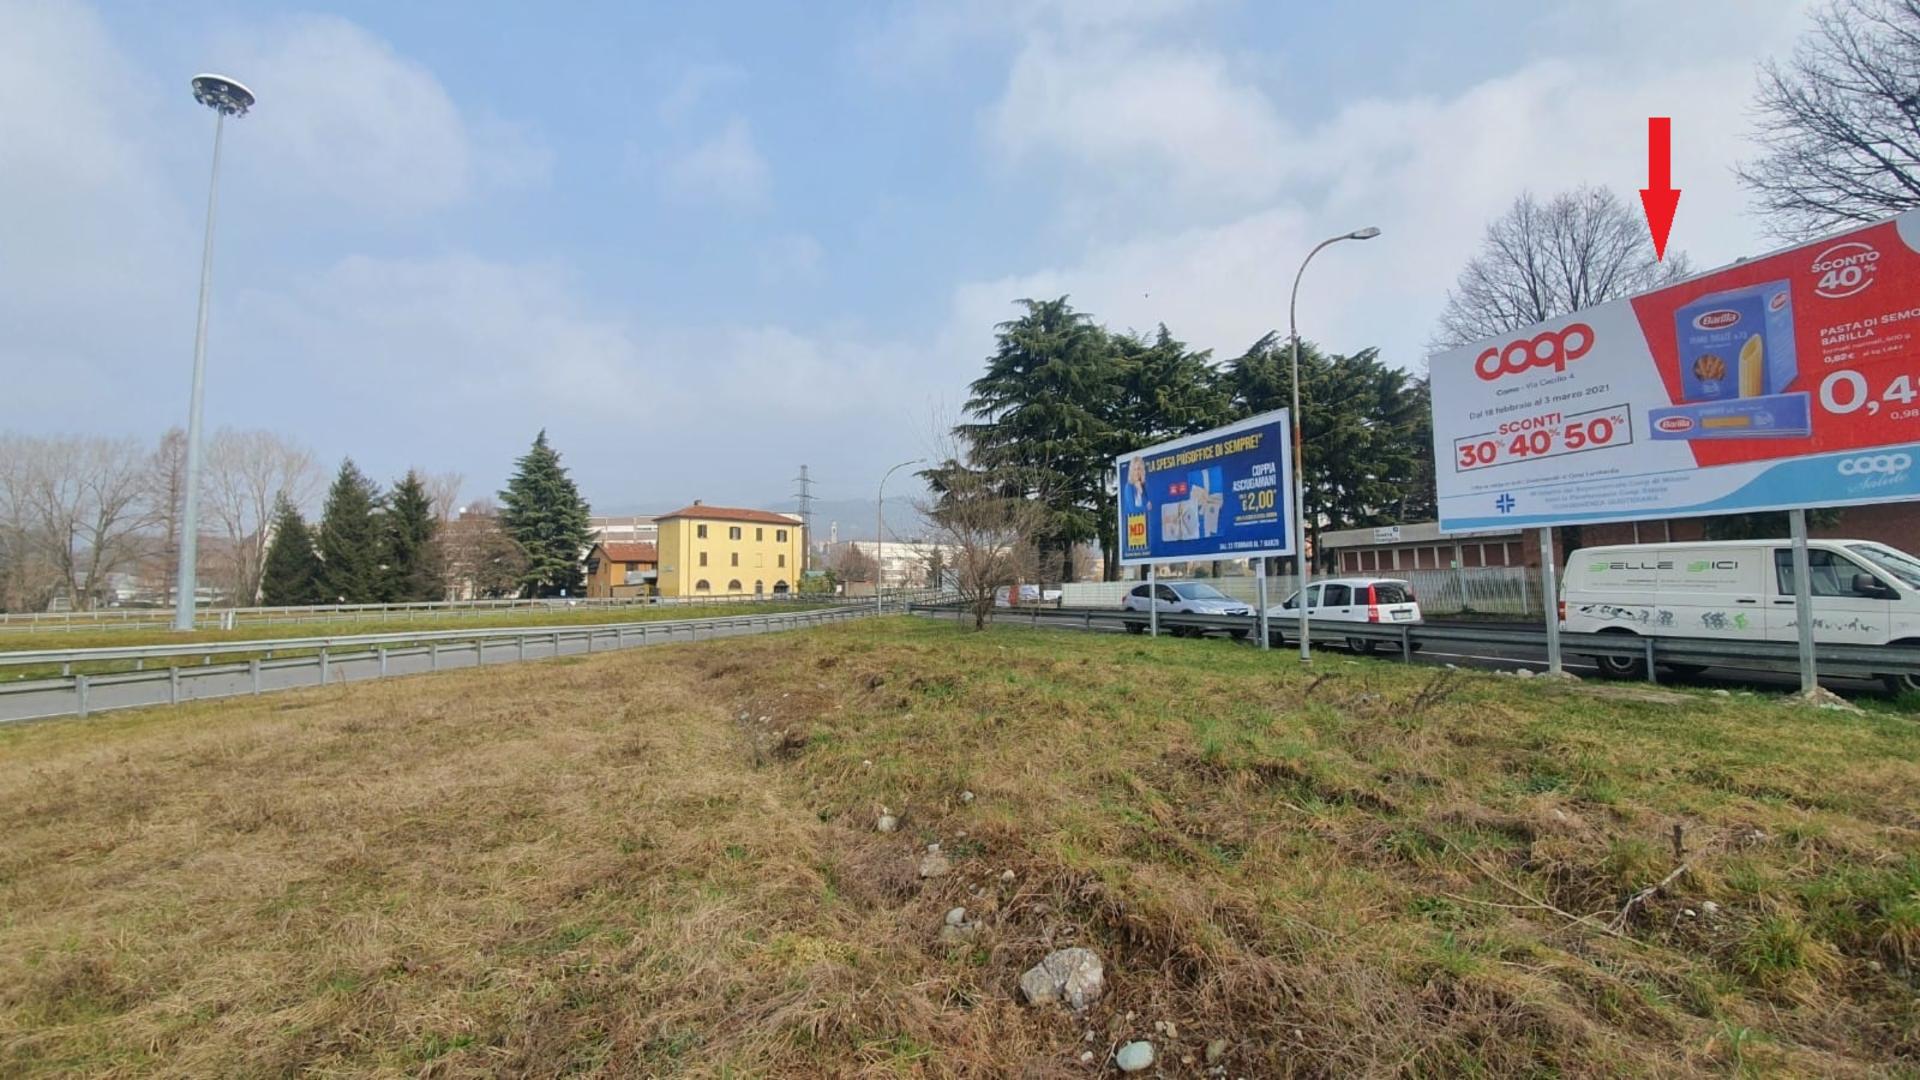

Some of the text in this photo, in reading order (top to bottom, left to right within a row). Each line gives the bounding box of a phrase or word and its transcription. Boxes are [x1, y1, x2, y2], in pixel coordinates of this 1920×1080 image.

[1812, 250, 1880, 273] SCONTO
[1817, 263, 1877, 289] 40%
[1702, 312, 1738, 326] Barilla
[1820, 321, 1862, 336] PASTA
[1864, 317, 1877, 328] DI
[1822, 328, 1875, 346] BARILLA
[1475, 322, 1595, 381] coop
[1526, 381, 1539, 390] Via
[1469, 383, 1610, 421] Dal 18 febbraio al 3 marzo 2021
[1820, 370, 1920, 427] 0,4
[1498, 412, 1561, 435] SCONTI
[1661, 418, 1692, 429] Barilla
[1459, 414, 1624, 468] 30% 40% 50%
[1156, 456, 1176, 471] SPESA
[1215, 444, 1224, 457] DI
[1252, 461, 1276, 477] COPPIA
[1838, 453, 1912, 476] coop
[1232, 474, 1276, 492] ASCIUGAMANI
